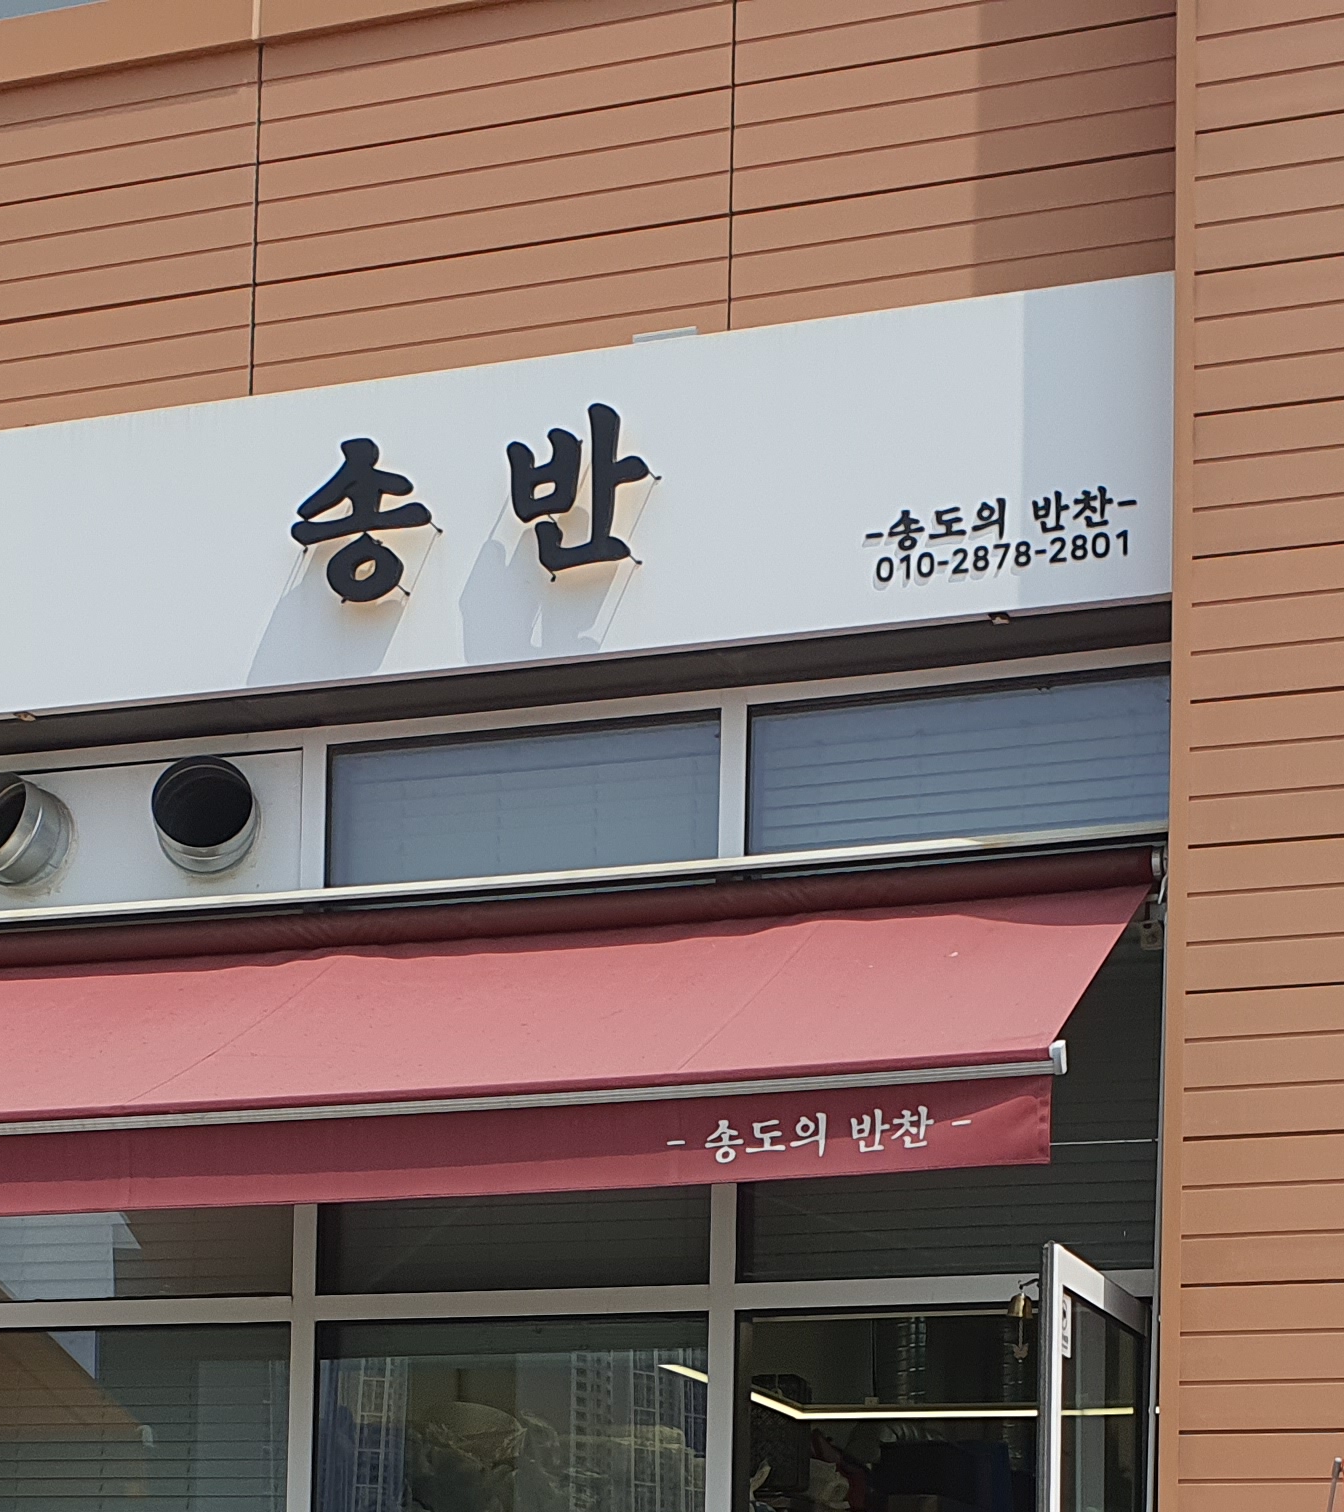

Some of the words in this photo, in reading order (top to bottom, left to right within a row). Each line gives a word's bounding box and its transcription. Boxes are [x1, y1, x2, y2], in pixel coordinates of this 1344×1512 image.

[875, 529, 1129, 583] 010-2878-2801
[704, 1111, 827, 1164] 송도의
[851, 1105, 935, 1152] 반찬
